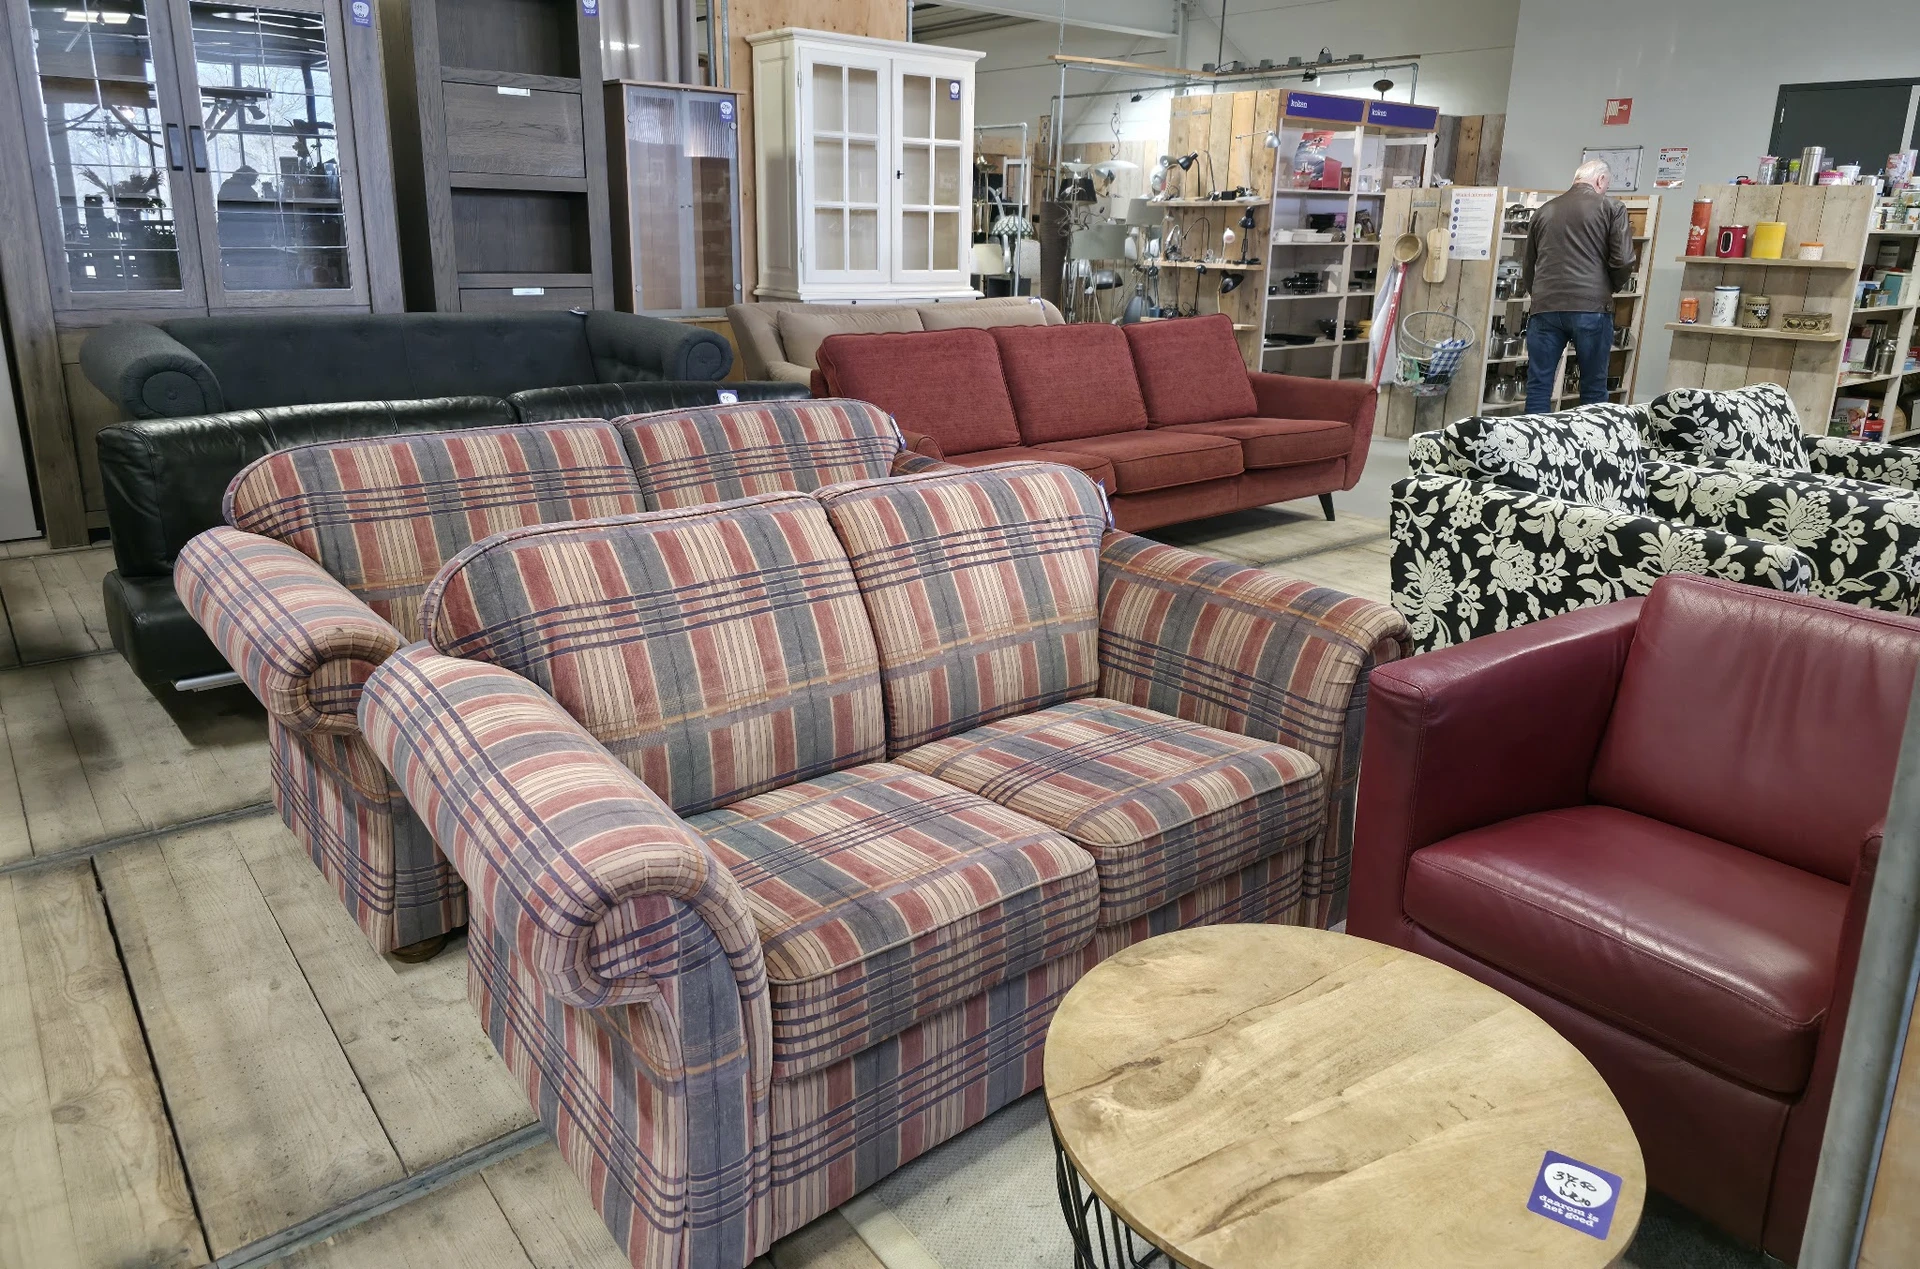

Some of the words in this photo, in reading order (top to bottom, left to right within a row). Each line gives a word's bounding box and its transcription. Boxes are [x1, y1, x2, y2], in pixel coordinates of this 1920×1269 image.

[1539, 1195, 1586, 1217] daarom
[1586, 1212, 1599, 1223] is
[1542, 1201, 1564, 1215] het
[1564, 1211, 1594, 1228] goed
